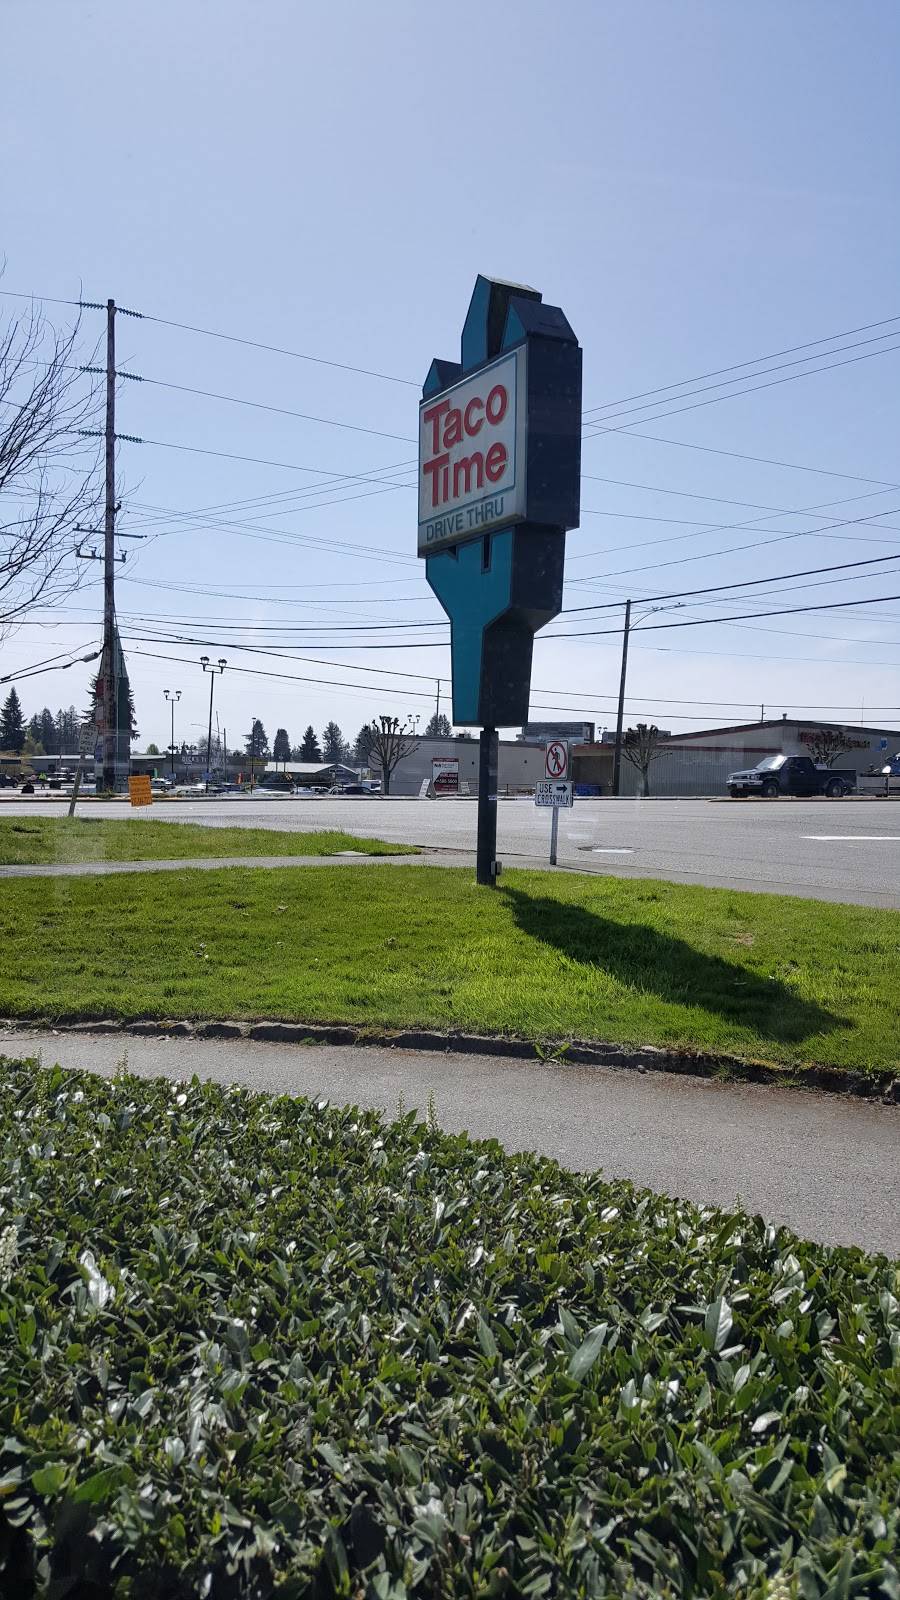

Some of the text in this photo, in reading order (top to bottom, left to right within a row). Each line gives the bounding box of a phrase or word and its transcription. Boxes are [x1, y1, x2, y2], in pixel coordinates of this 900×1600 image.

[423, 384, 508, 455] Taco
[423, 442, 508, 508] Time
[426, 497, 504, 542] DRIVE THRU
[537, 794, 570, 805] CROSSWALK
[539, 783, 553, 794] USE
